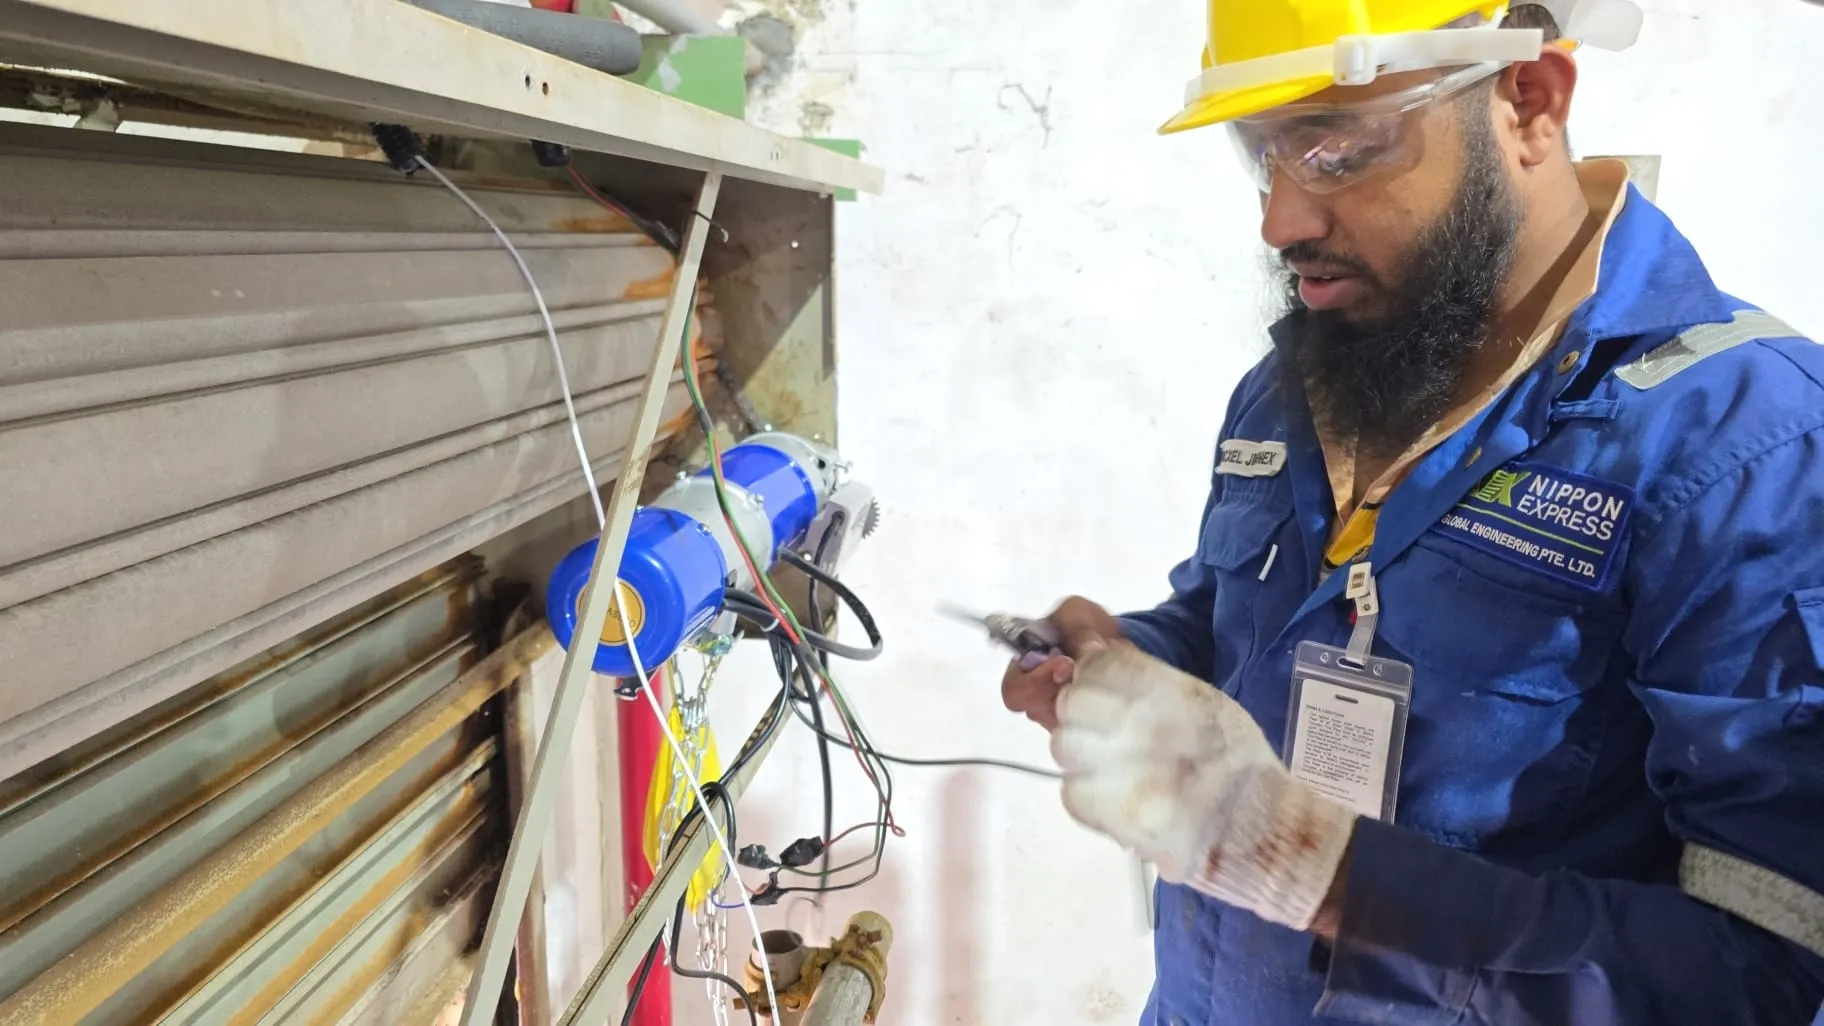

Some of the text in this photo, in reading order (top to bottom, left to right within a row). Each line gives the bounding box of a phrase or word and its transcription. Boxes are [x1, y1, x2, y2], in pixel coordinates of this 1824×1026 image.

[1516, 494, 1615, 541] EXPRESS
[1528, 474, 1624, 521] NIPPON
[1441, 514, 1596, 578] GLOBAL ENGINEERING PTE. LTD.
